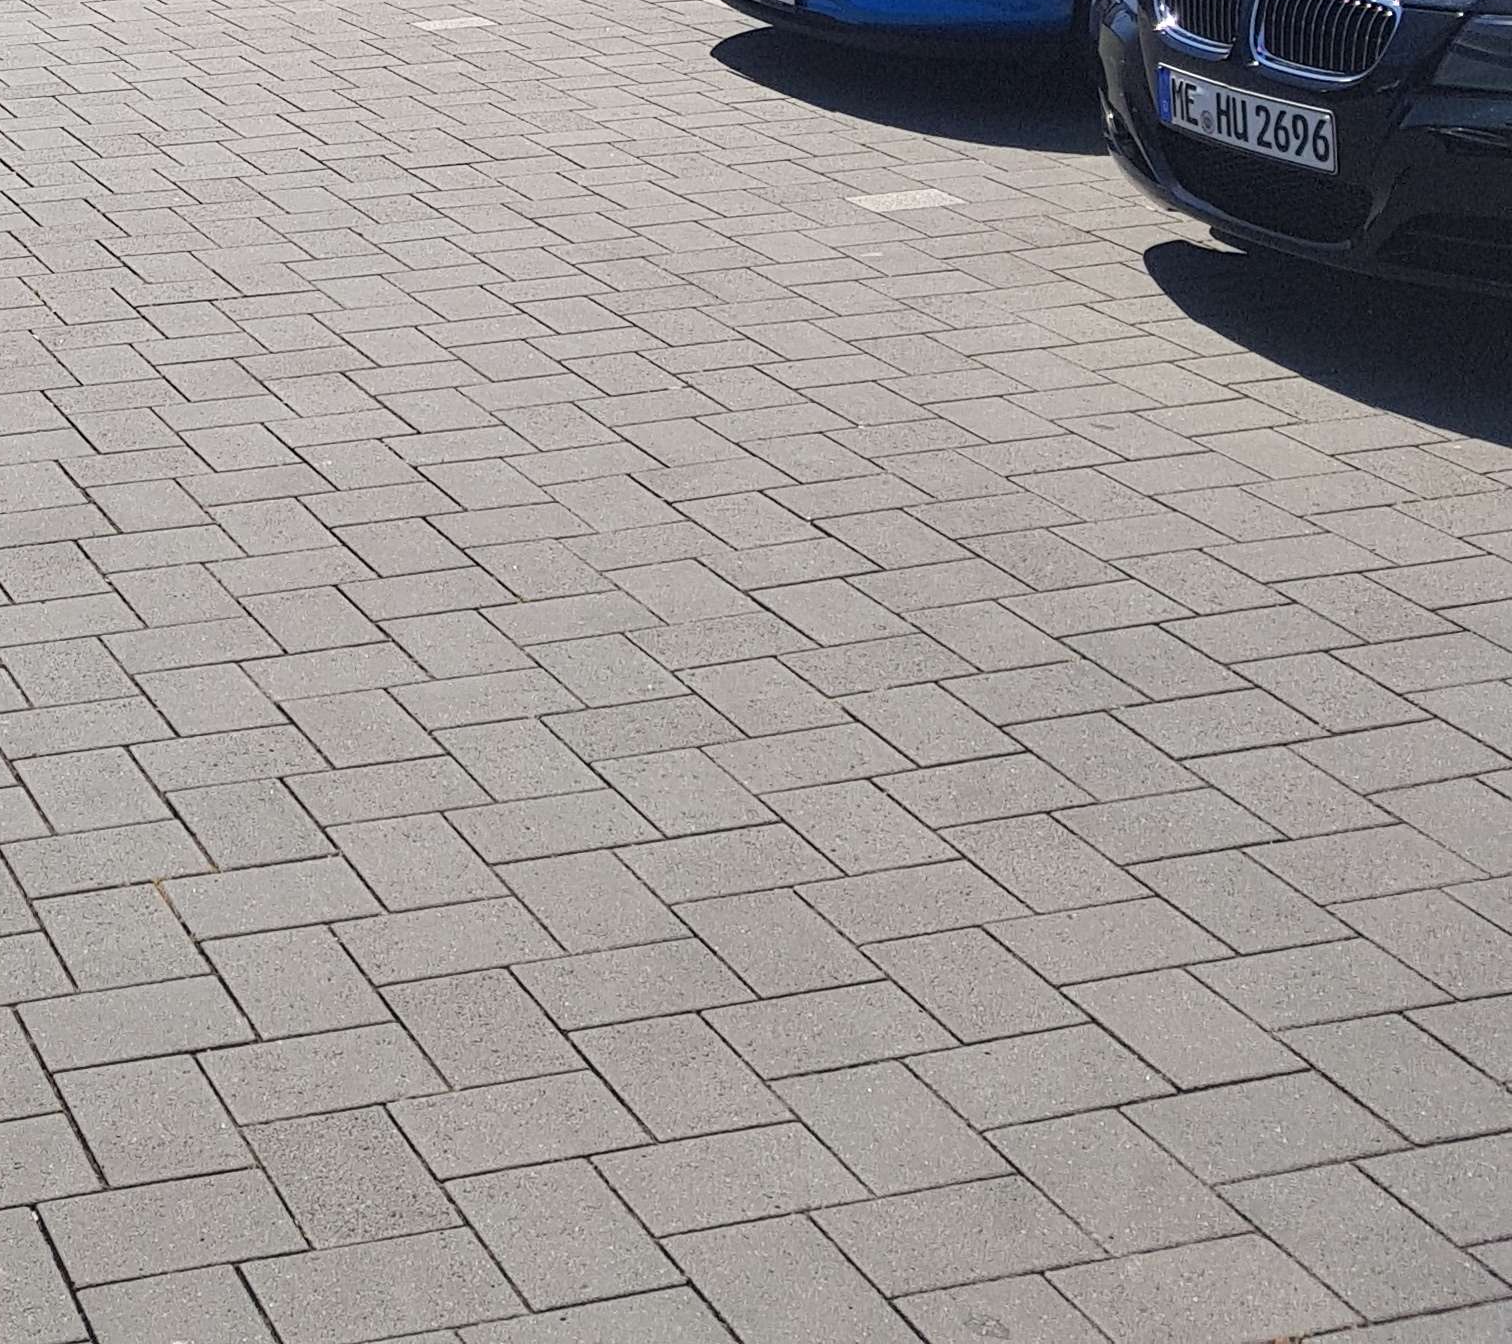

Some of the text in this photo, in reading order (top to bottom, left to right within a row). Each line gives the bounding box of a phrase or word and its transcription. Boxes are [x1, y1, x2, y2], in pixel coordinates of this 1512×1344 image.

[1171, 77, 1330, 162] ME HU 2696
